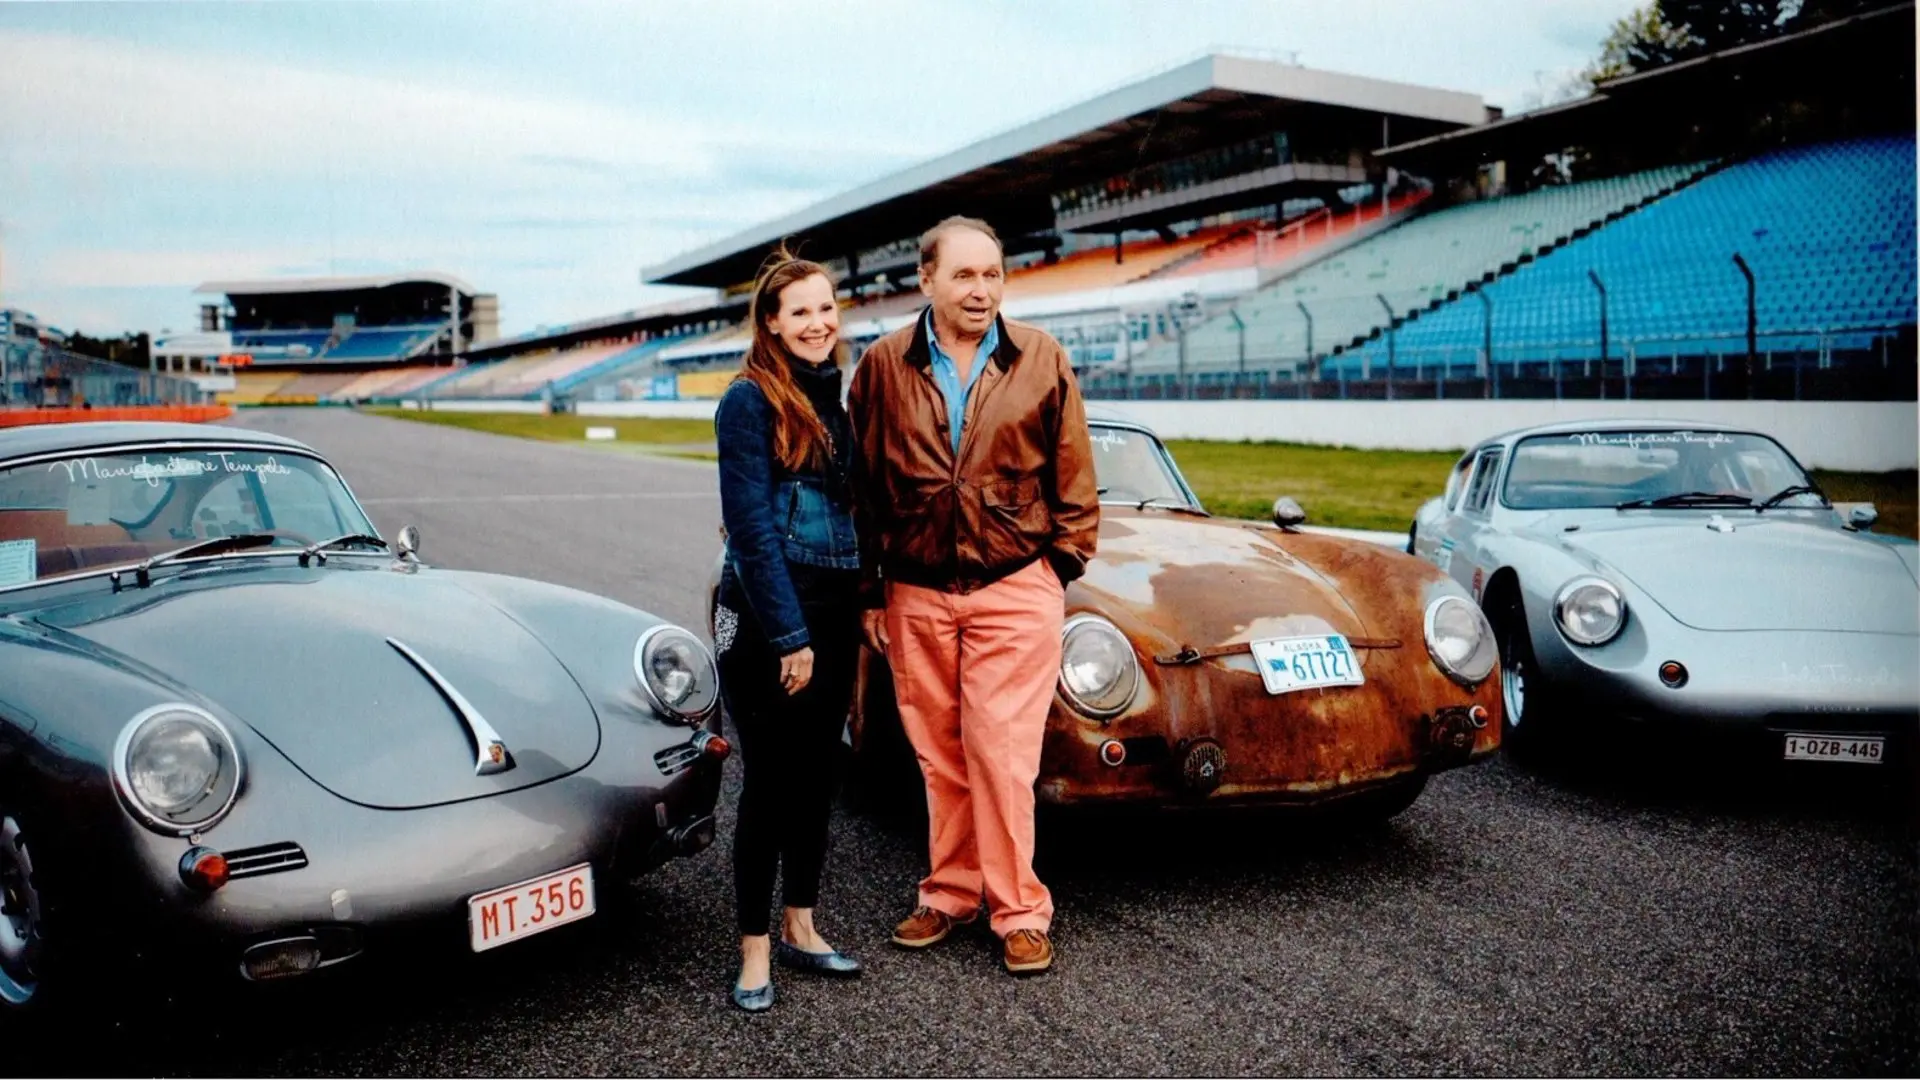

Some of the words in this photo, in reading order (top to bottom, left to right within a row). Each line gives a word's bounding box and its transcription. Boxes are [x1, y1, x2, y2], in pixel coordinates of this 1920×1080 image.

[1291, 650, 1353, 681] 67727
[1789, 739, 1880, 758] 1-OZB-445
[481, 877, 584, 940] MT.356
